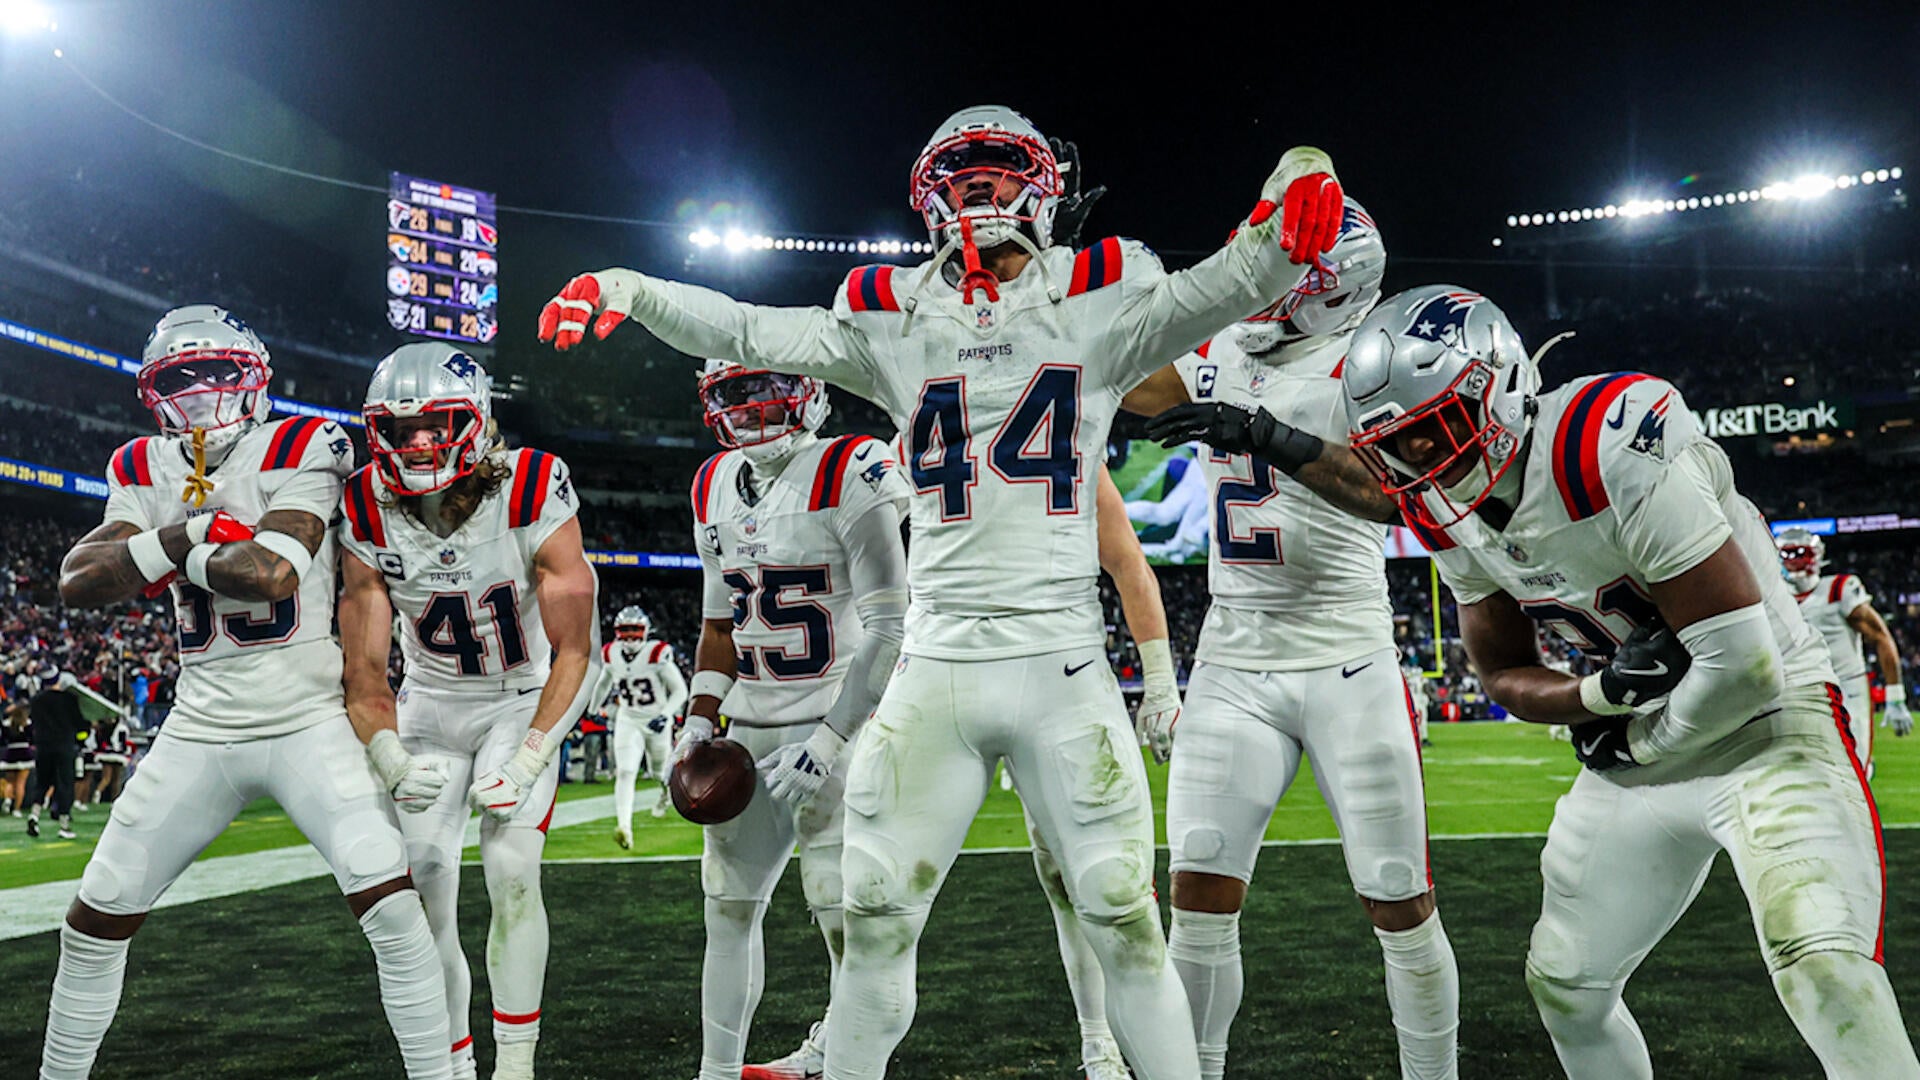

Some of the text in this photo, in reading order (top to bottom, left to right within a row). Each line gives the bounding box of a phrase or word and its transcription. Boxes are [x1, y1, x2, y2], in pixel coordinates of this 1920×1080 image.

[409, 207, 428, 231] 26
[462, 218, 478, 242] 19
[410, 239, 428, 264] 34
[460, 249, 478, 273] 20
[410, 272, 428, 297] 29
[460, 281, 479, 306] 24
[410, 305, 426, 330] 21
[460, 314, 478, 338] 23
[958, 343, 1013, 362] PATRIOTS
[1198, 366, 1217, 391] C
[909, 362, 1083, 523] 44
[37, 469, 64, 489] YEARS
[1209, 447, 1284, 565] 2
[737, 544, 768, 555] PATRIOTS
[379, 553, 405, 579] C
[430, 570, 473, 583] PATRIOTS
[1520, 572, 1567, 588] PATRIOTS
[415, 580, 530, 676] 41
[722, 564, 836, 681] 25
[618, 677, 656, 707] 43
